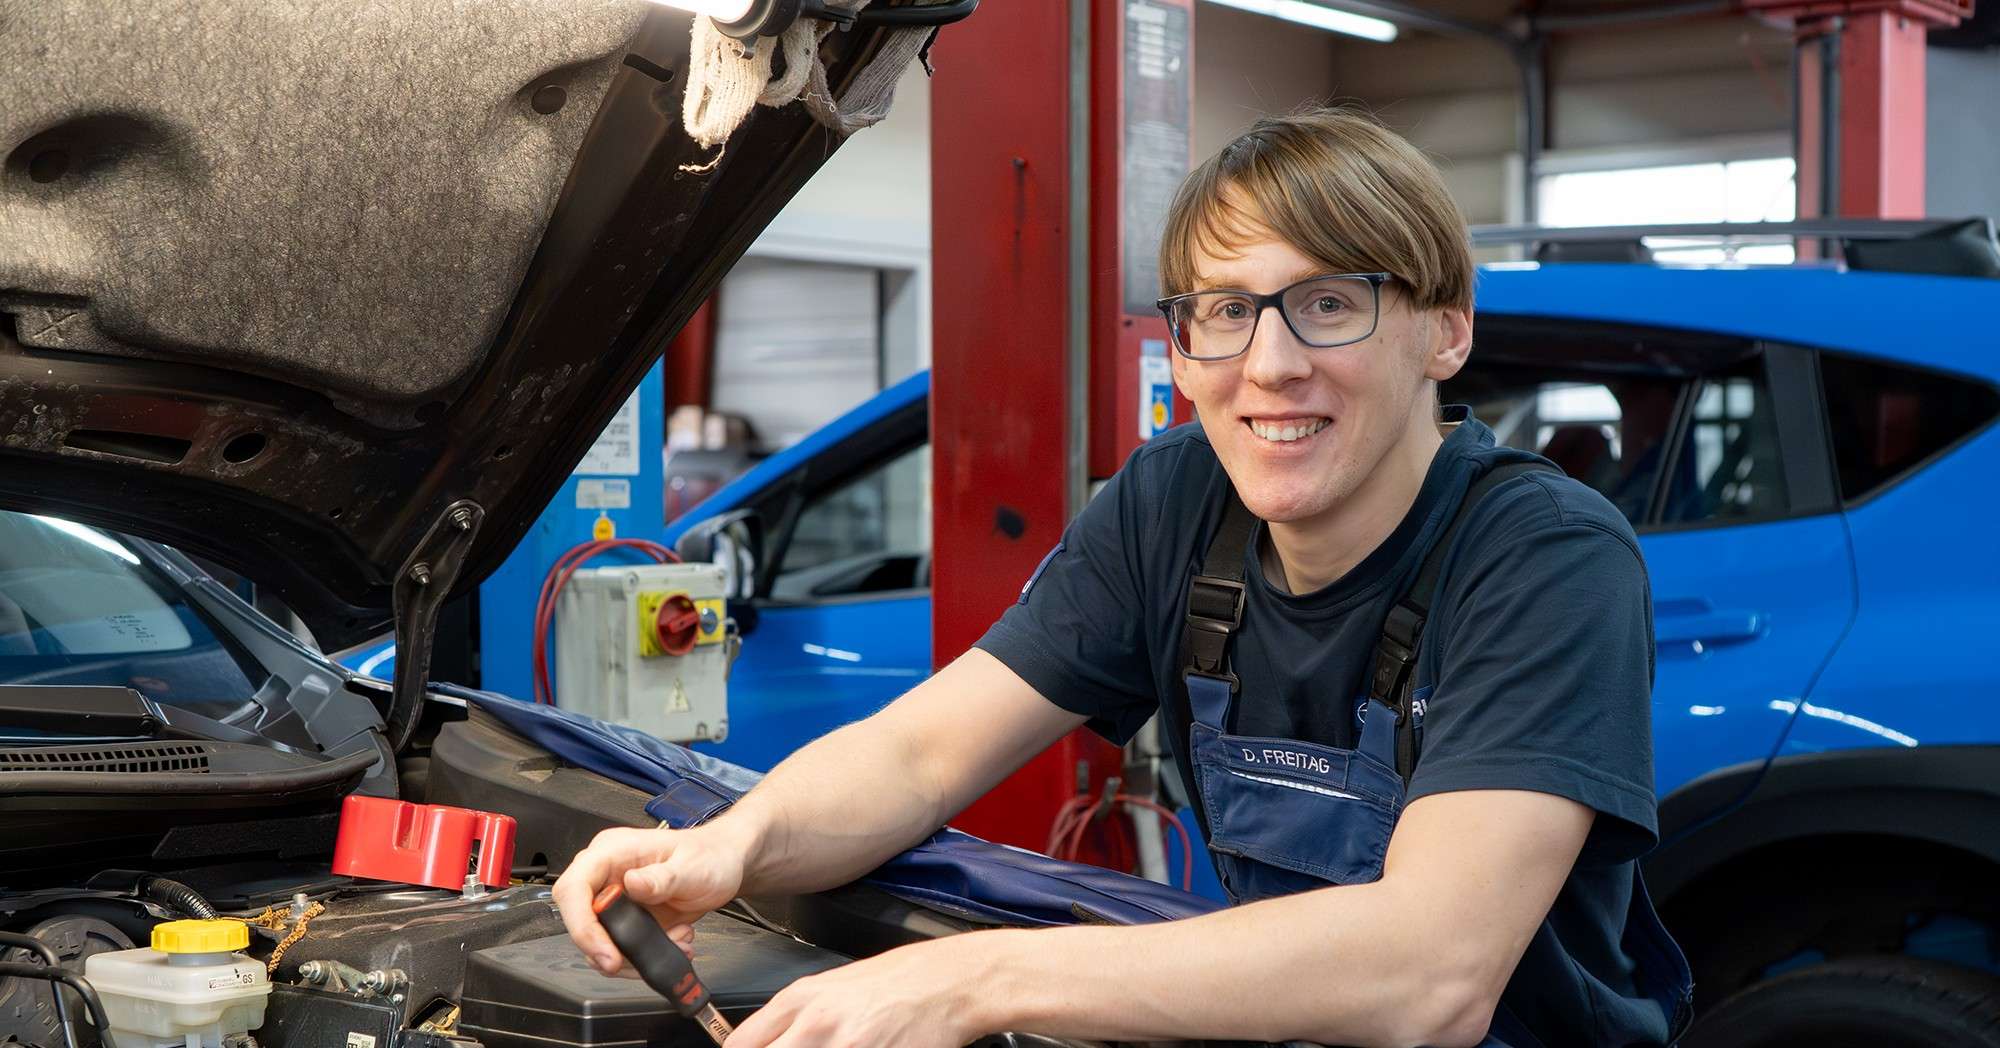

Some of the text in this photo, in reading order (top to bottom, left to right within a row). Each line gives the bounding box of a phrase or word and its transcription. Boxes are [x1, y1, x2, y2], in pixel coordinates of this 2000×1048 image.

[1242, 748, 1330, 773] D. FREITAG
[242, 973, 253, 984] GS
